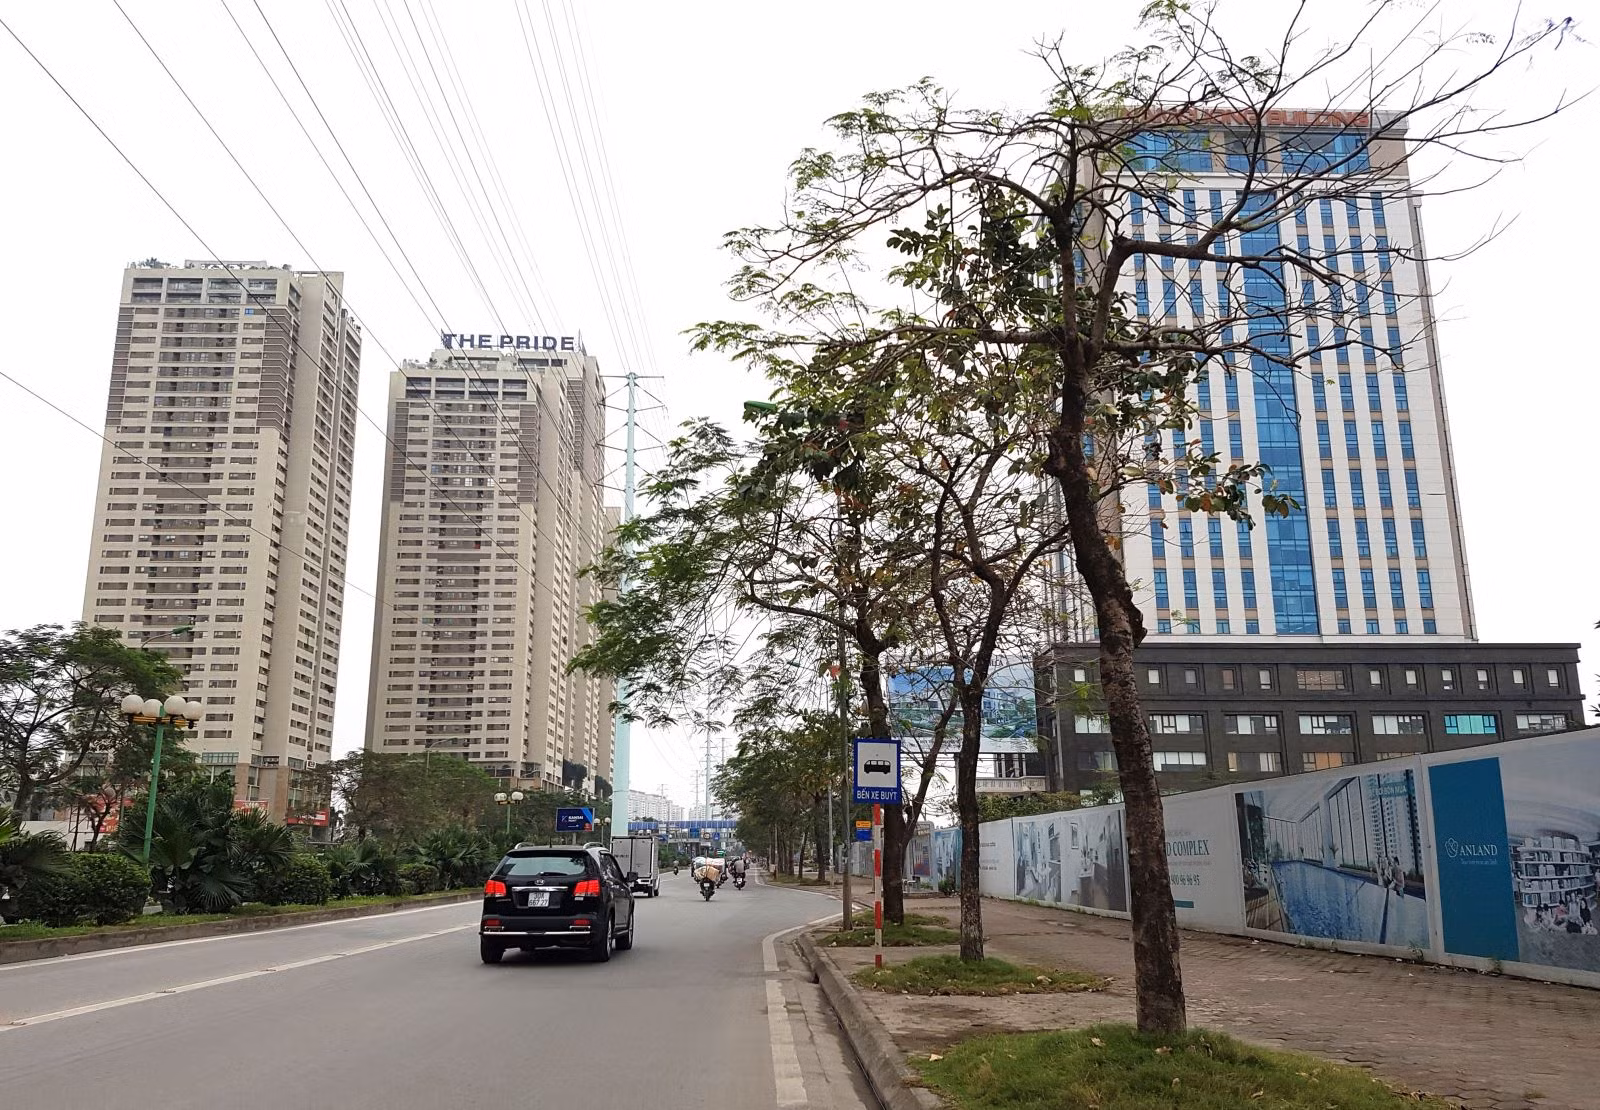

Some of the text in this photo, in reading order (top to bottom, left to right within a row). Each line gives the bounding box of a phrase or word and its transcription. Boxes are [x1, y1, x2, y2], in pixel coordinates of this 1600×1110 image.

[443, 333, 575, 350] THE PRIDE
[857, 787, 869, 799] BẾN
[870, 790, 880, 799] XE
[1172, 840, 1210, 857] COMPLEX
[1460, 844, 1498, 856] ANLAND
